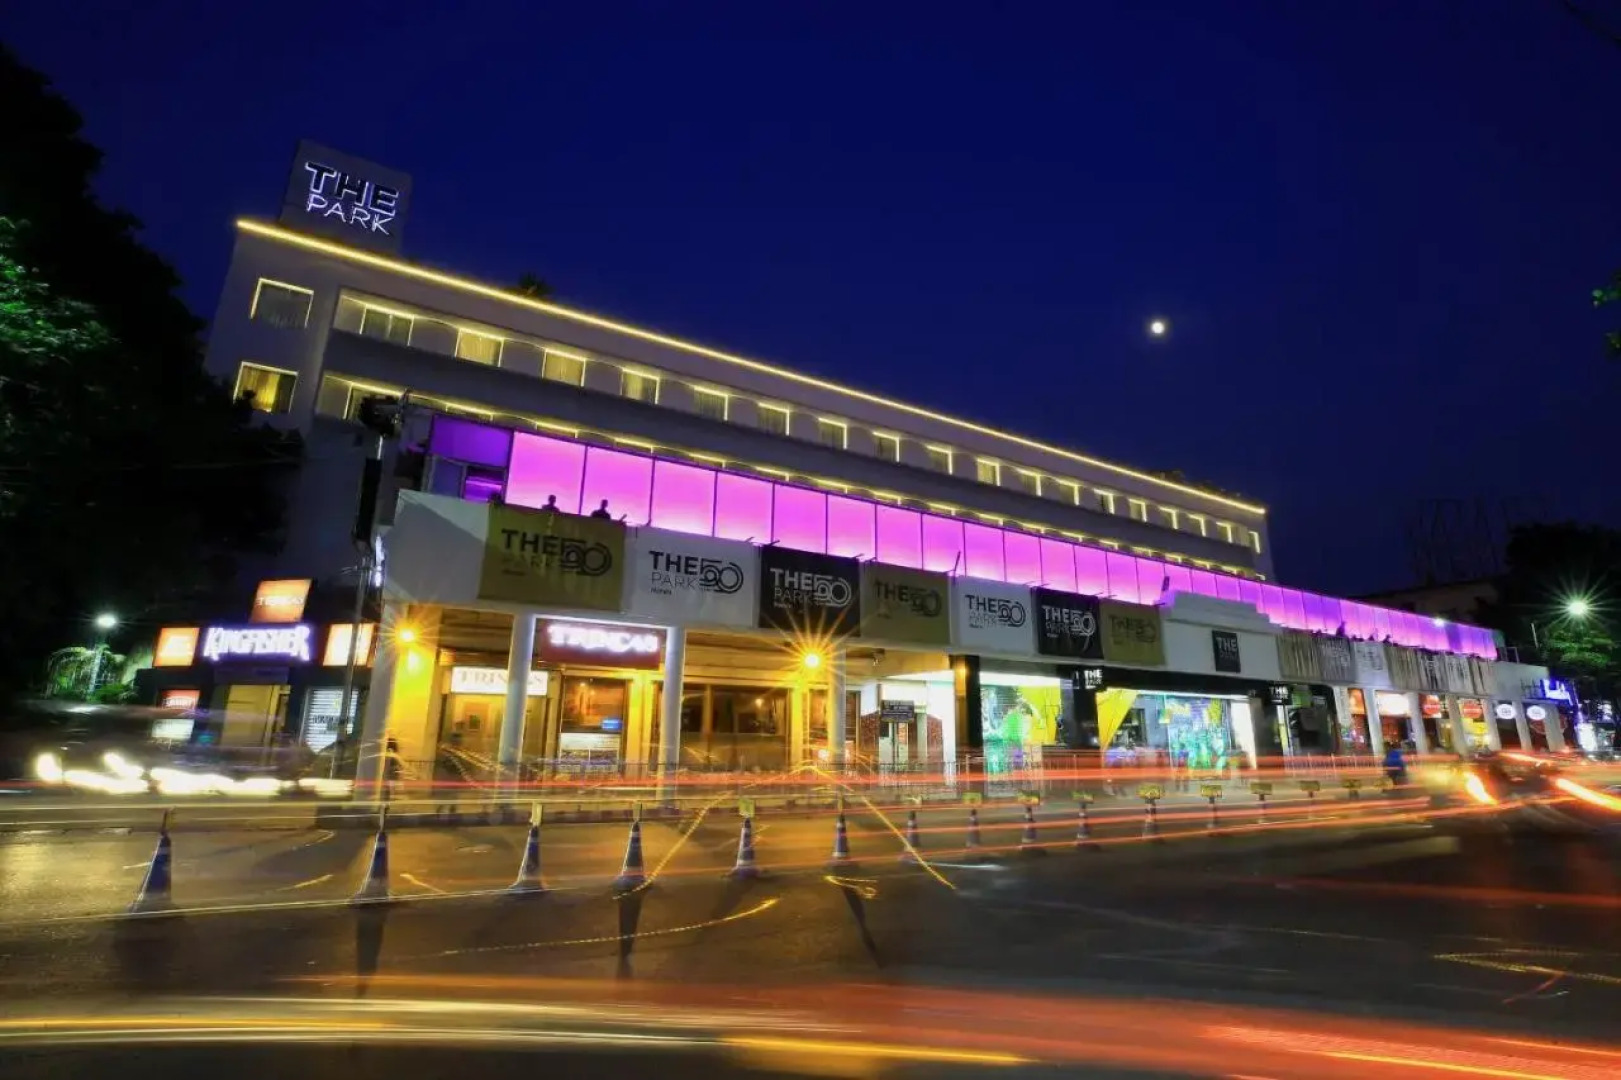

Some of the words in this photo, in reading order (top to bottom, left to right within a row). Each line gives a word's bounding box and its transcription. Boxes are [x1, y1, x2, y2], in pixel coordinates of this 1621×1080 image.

[305, 161, 399, 217] THE
[305, 193, 394, 236] PARK
[501, 528, 560, 556] THE
[648, 550, 699, 576] THE
[651, 571, 698, 590] PARK
[769, 567, 813, 591] THE
[875, 580, 909, 602] THE
[965, 594, 998, 614] THE
[1041, 604, 1070, 623] THE
[1215, 636, 1237, 651] THE
[1084, 669, 1103, 679] THE
[1268, 686, 1289, 695] THE
